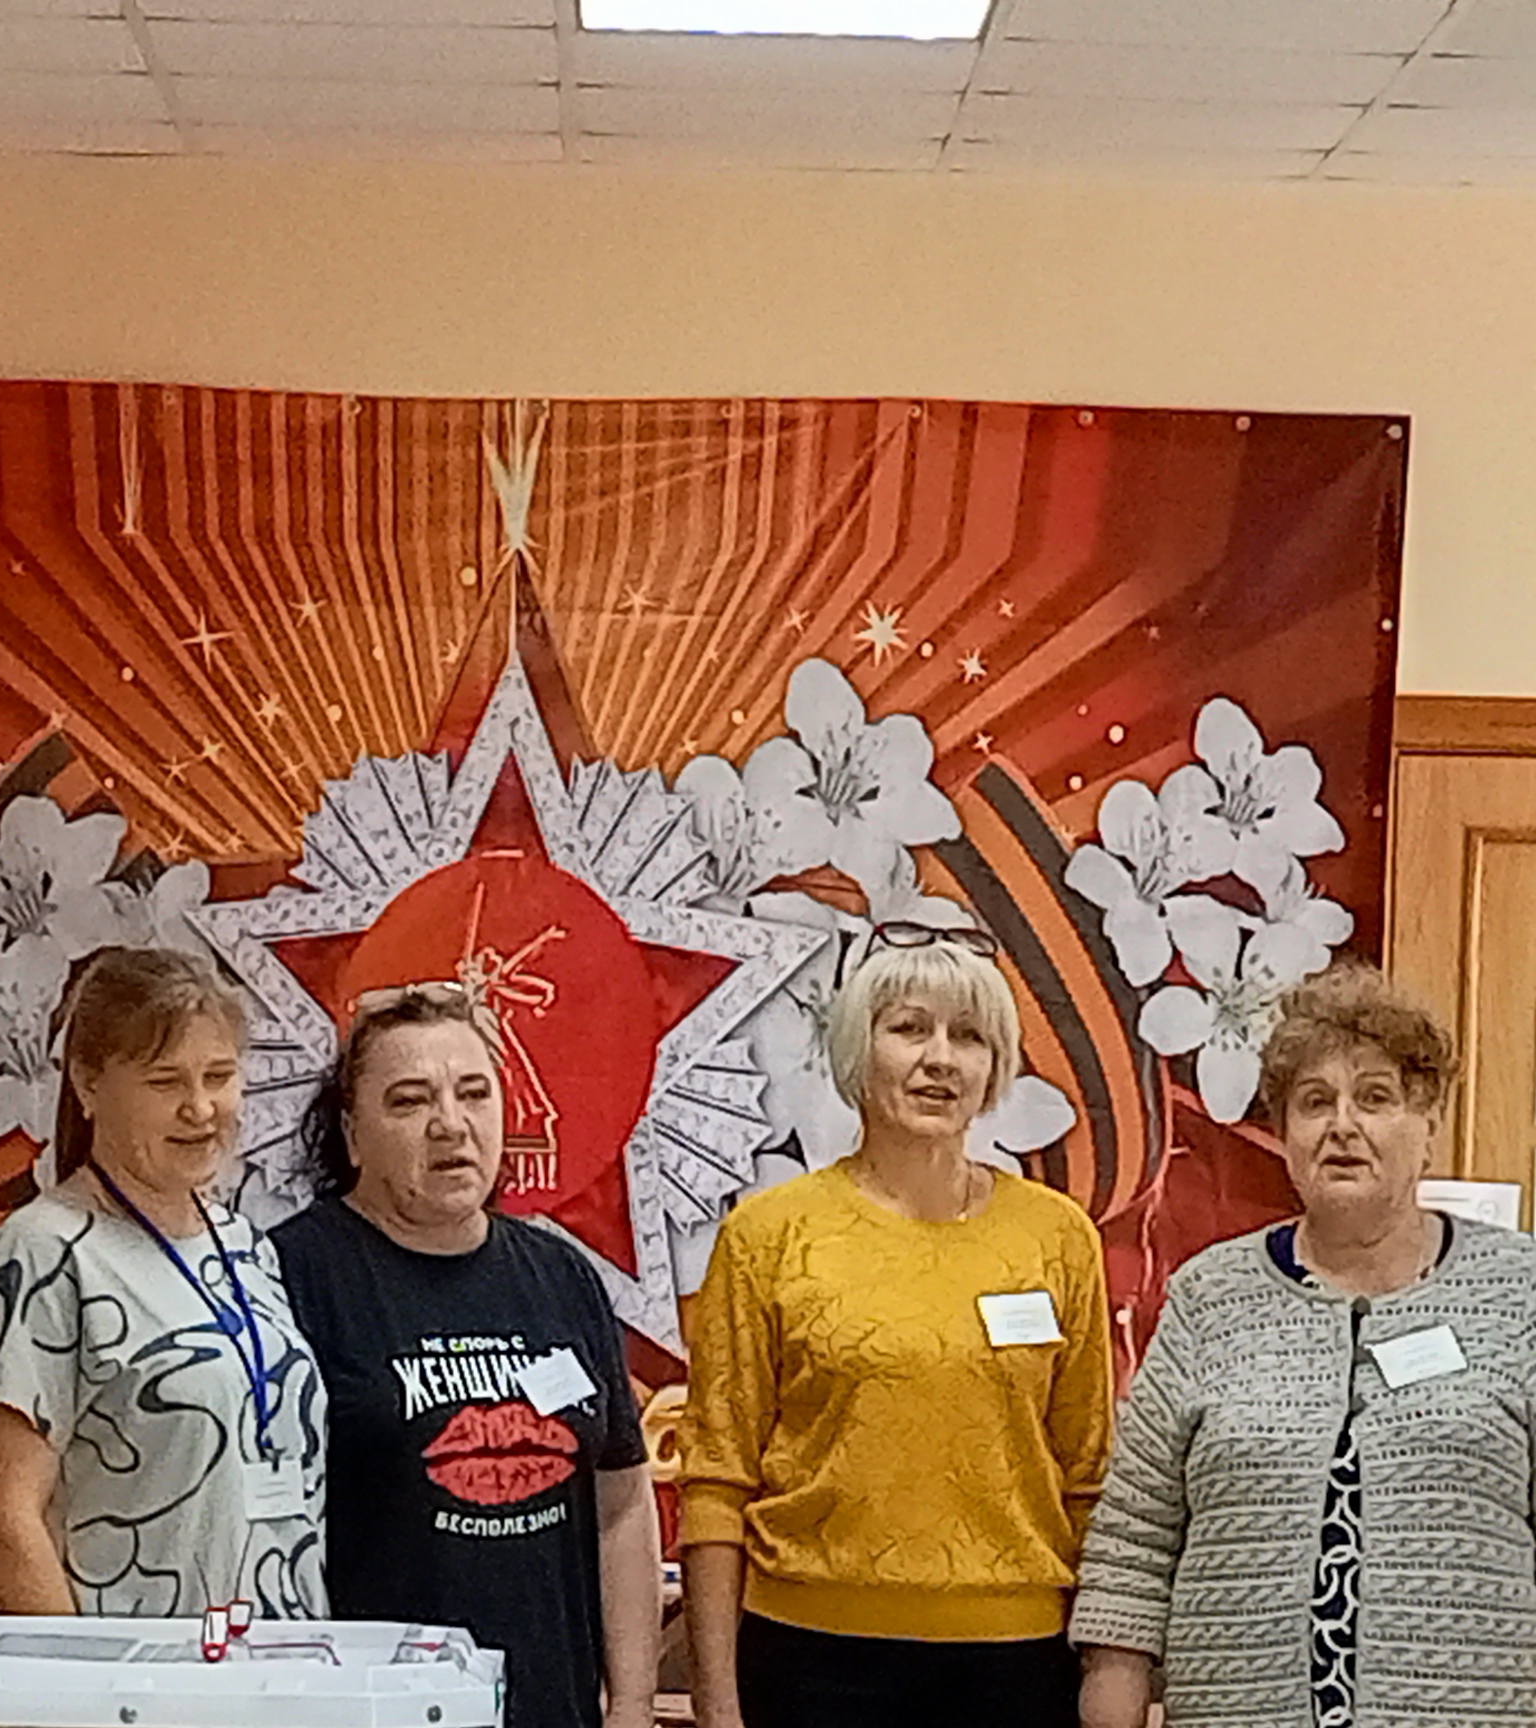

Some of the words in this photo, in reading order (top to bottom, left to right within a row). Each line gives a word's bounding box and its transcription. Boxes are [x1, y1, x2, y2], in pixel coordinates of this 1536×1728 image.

[420, 1337, 446, 1352] НЕ
[447, 1336, 510, 1352] СПОРЬ
[511, 1335, 525, 1351] С
[434, 1502, 567, 1537] БЕСПОЛЕЗНО!
